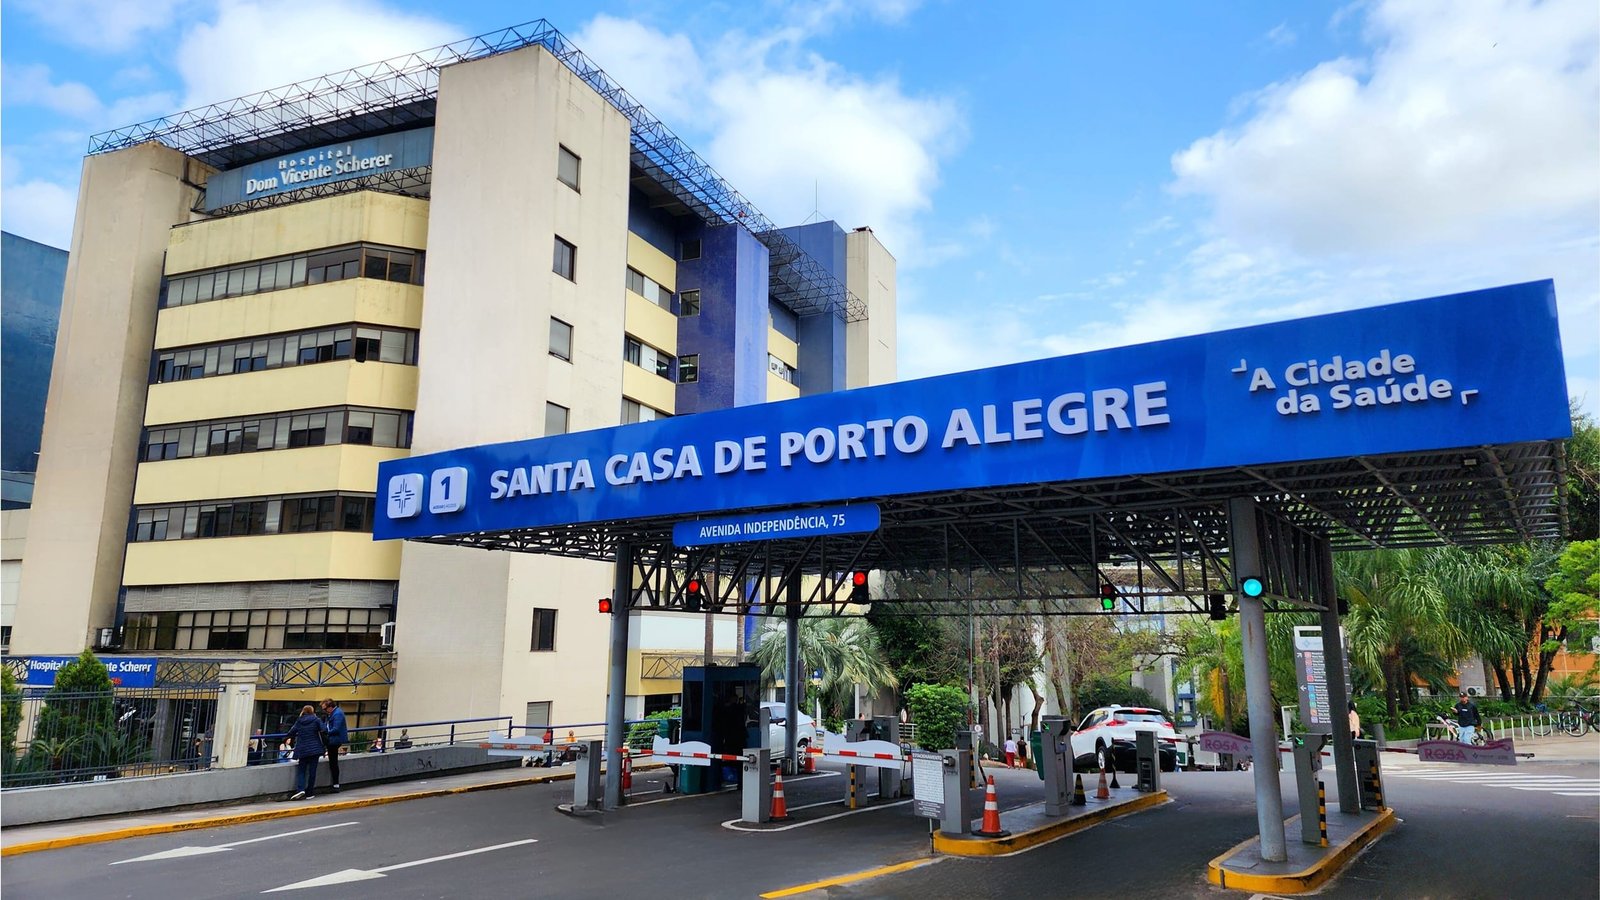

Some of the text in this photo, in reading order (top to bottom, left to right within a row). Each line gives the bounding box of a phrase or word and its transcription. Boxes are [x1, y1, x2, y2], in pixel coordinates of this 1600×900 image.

[278, 146, 352, 170] Hospital
[246, 152, 393, 195] Dom Vicente Scherer
[1249, 349, 1416, 392] A Cidade
[1276, 374, 1453, 416] da Saúde
[490, 380, 1171, 500] SANTA CASA DE PORTO ALEGRE
[440, 475, 451, 500] 1
[700, 514, 846, 538] AVENIDA INDEPENDÊNCIA, 75
[30, 660, 63, 671] Hospital
[1205, 739, 1240, 751] ROSA
[1423, 748, 1467, 760] ROSA
